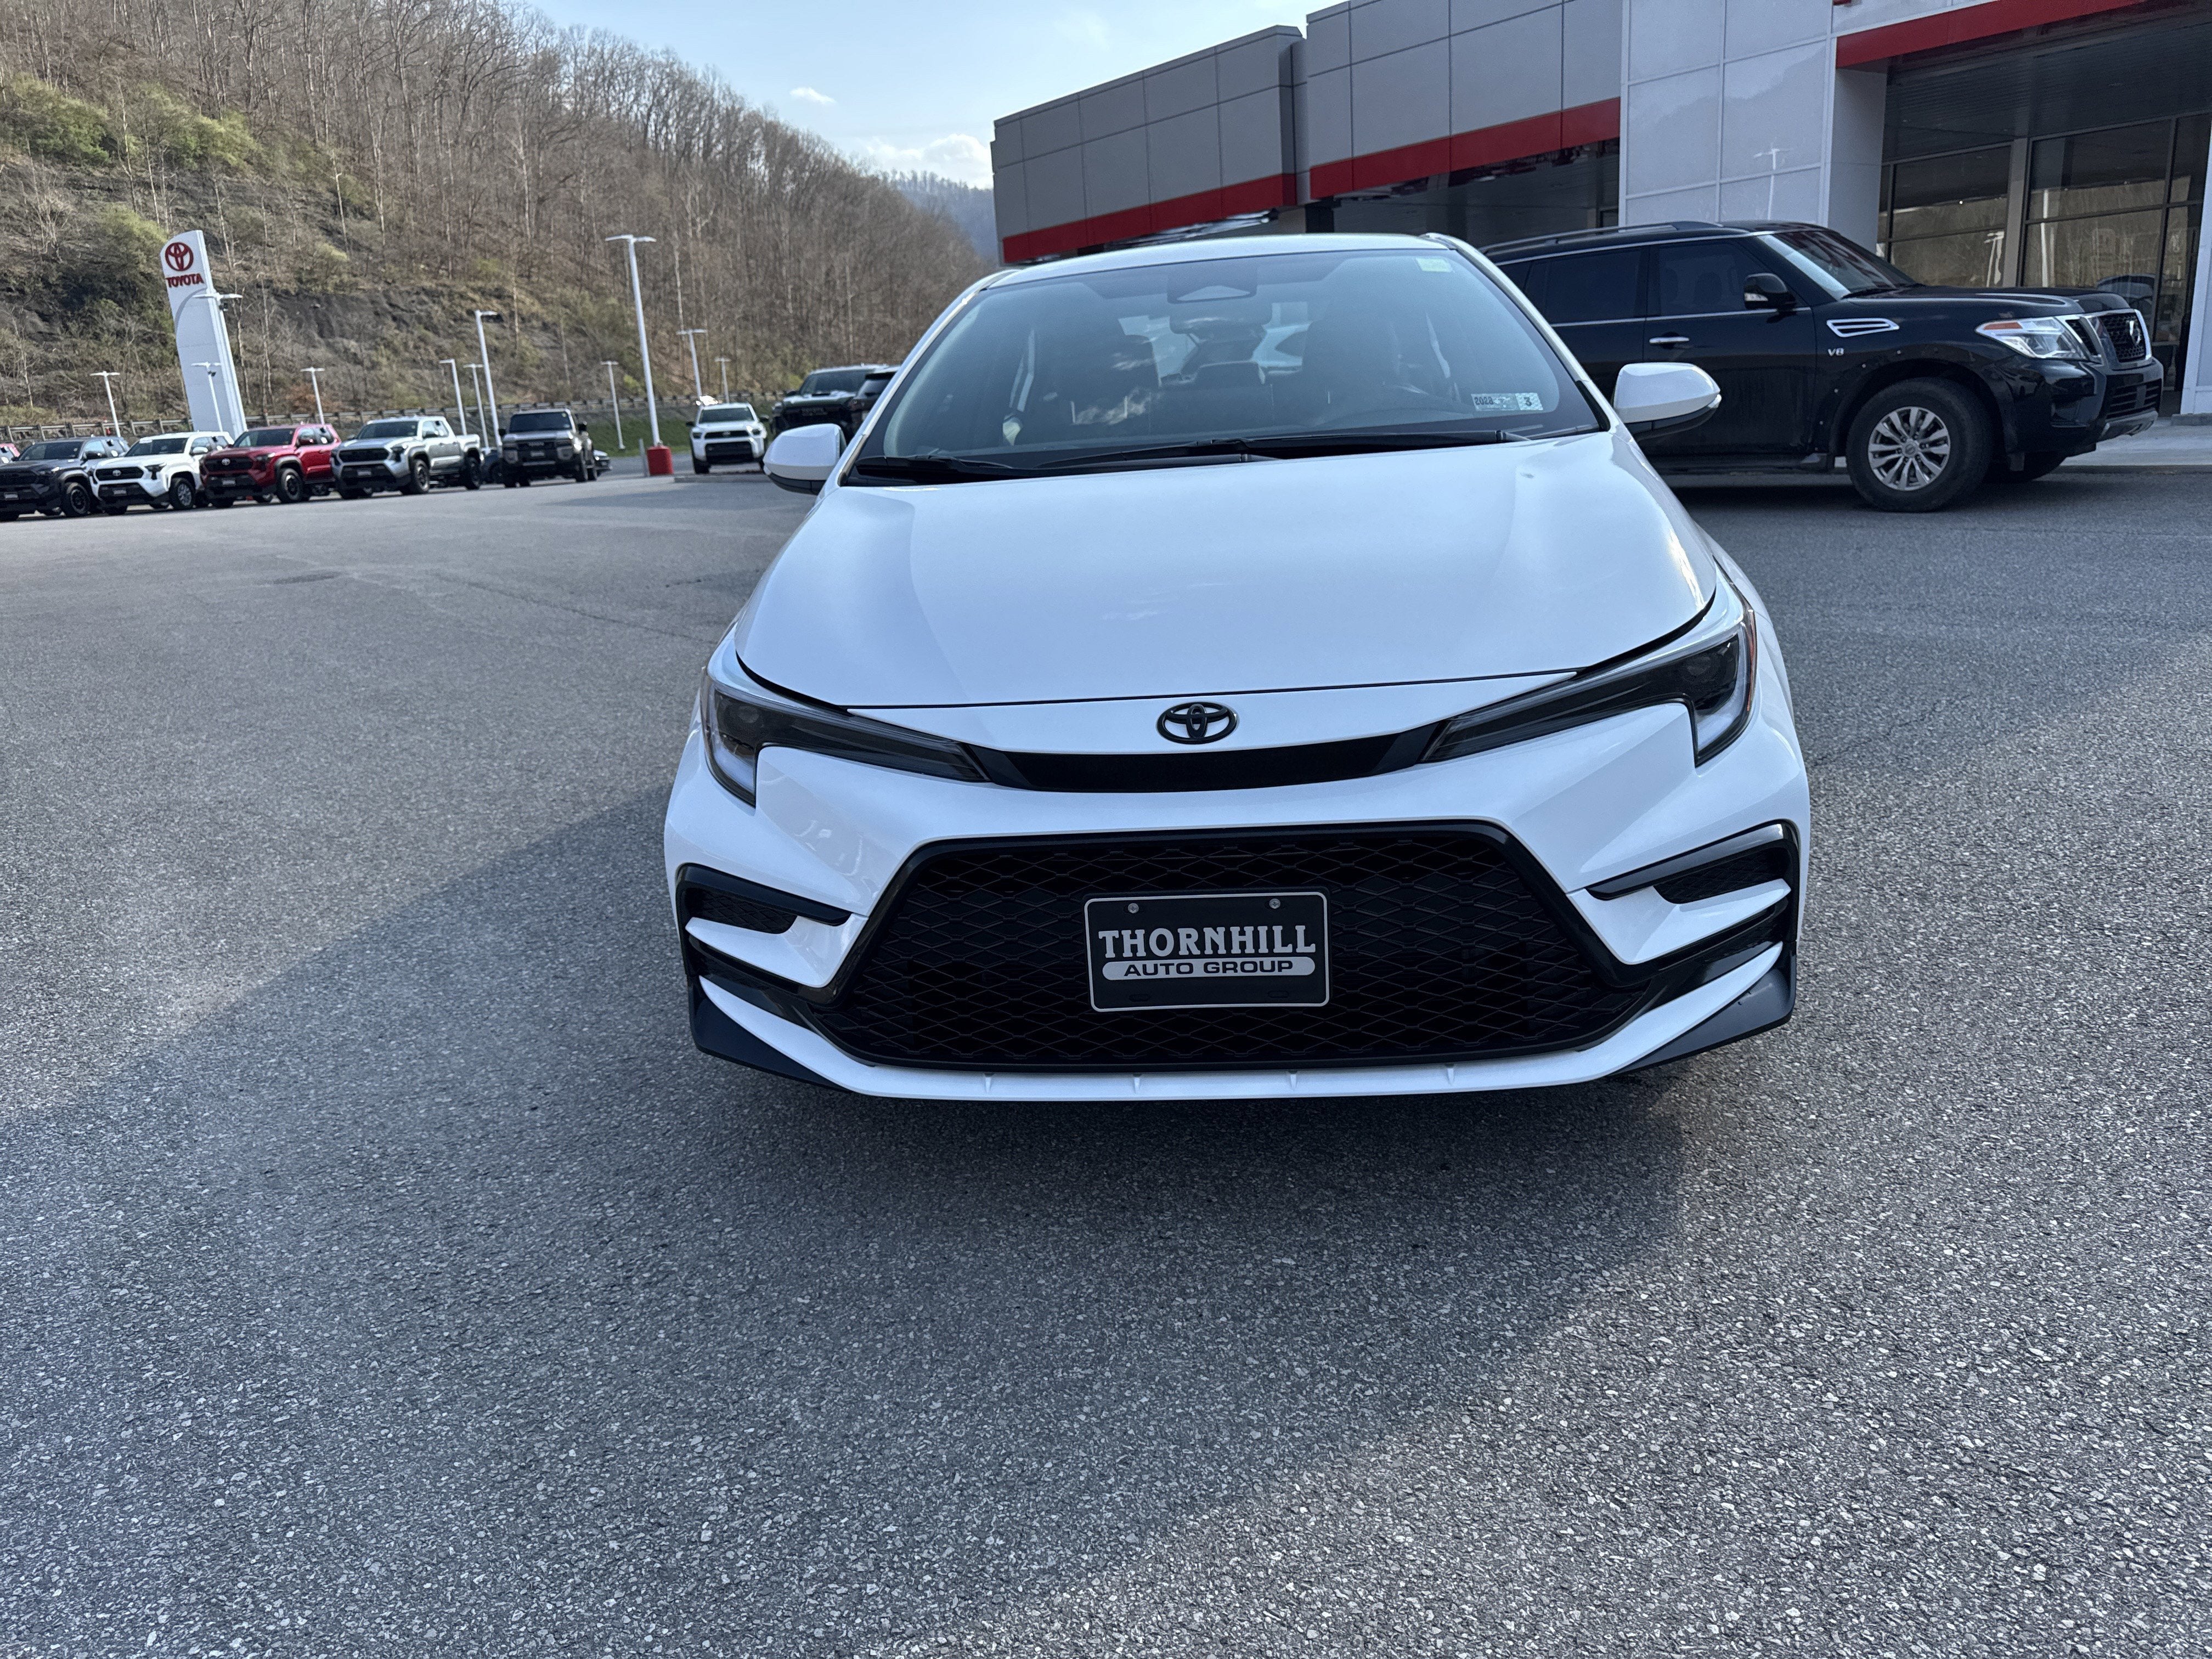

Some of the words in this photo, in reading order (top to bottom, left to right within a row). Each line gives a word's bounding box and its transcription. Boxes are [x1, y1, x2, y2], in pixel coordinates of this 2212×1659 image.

[166, 274, 204, 287] TOYOTA
[1827, 347, 1844, 357] V8
[1523, 397, 1532, 407] 3
[1098, 925, 1316, 958] THORNHILL
[1124, 962, 1193, 977] AUTO
[1203, 960, 1293, 974] GROUP
